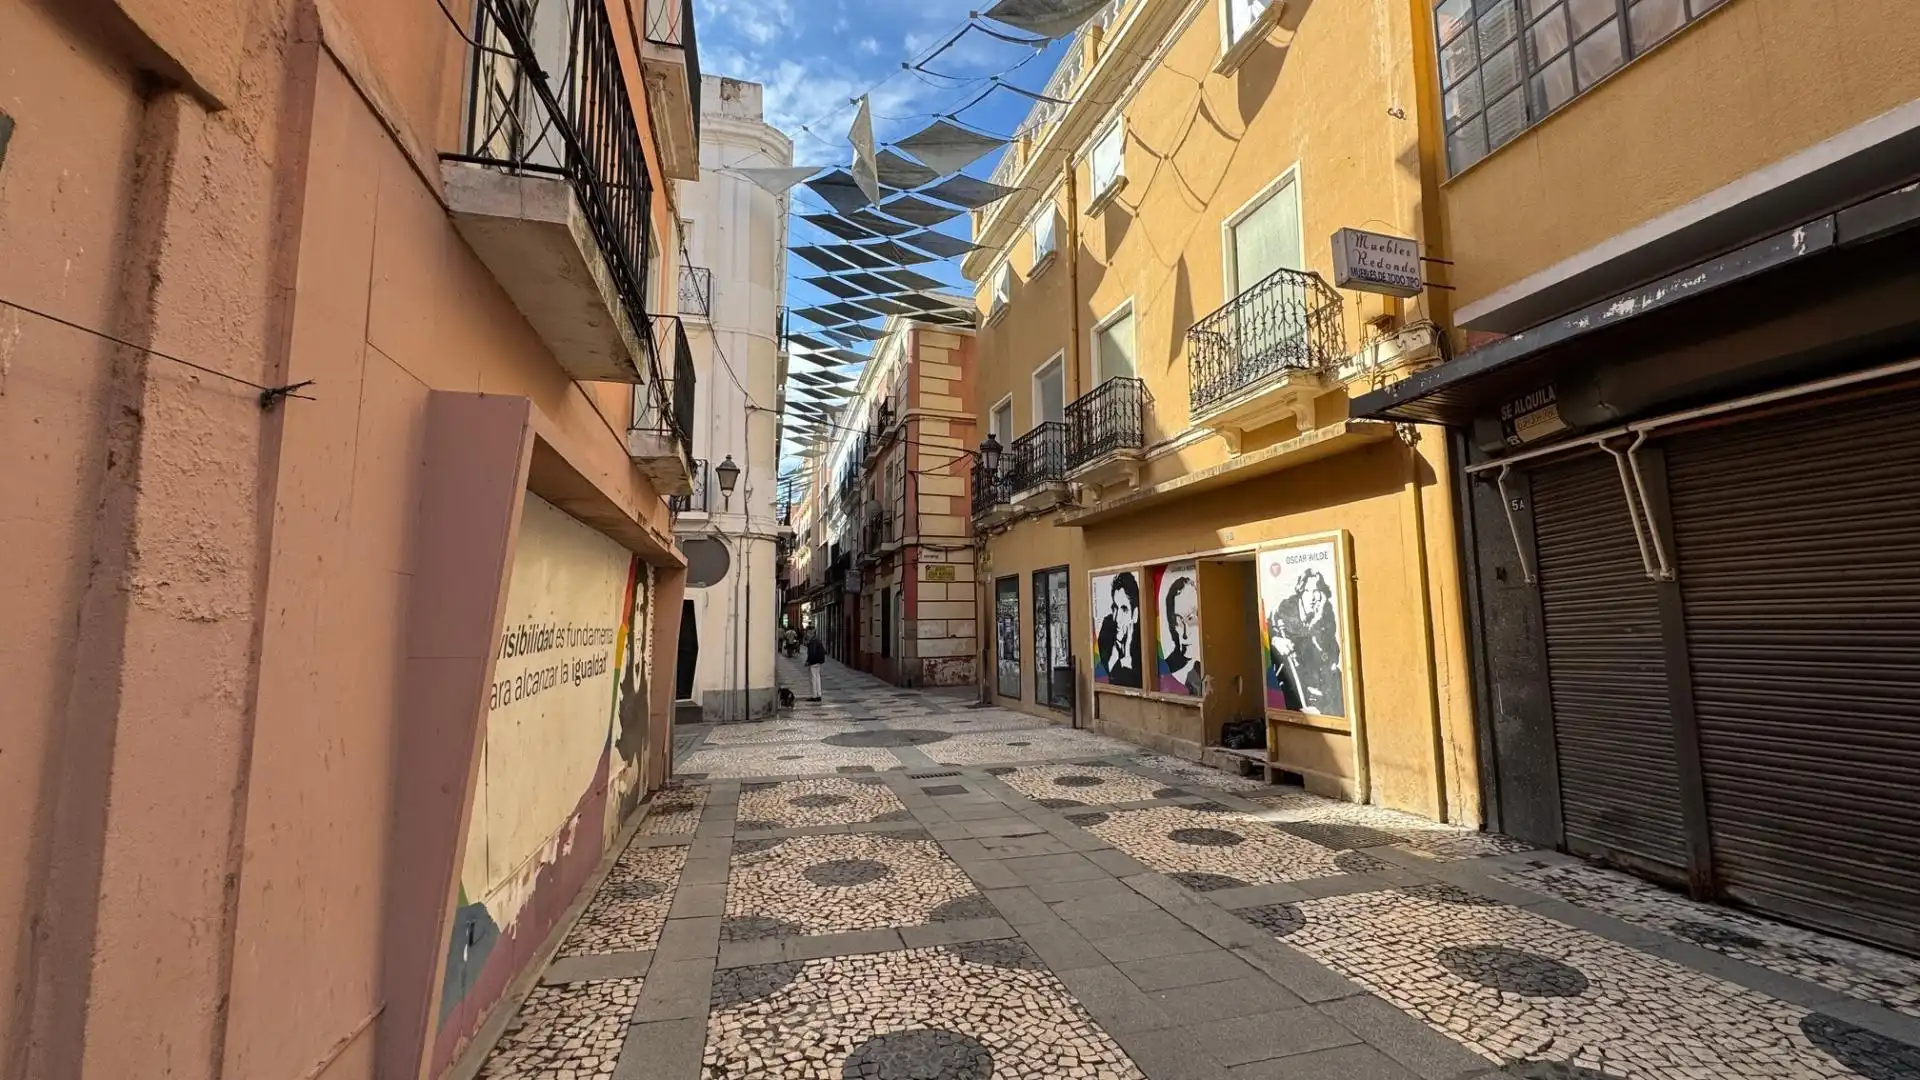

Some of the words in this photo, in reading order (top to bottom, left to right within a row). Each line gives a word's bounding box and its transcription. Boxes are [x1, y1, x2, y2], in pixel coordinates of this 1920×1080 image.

[1355, 233, 1411, 256] Muebles
[1353, 249, 1416, 274] Redondo
[1377, 271, 1386, 281] DE
[1387, 272, 1406, 285] TODO
[1501, 403, 1513, 421] SE
[1514, 385, 1556, 416] ALQUILA
[1511, 499, 1525, 511] 5A
[1285, 554, 1307, 565] OSCAR
[1308, 551, 1329, 562] WILDE
[555, 627, 566, 649] es
[490, 679, 512, 711] ara
[515, 667, 559, 702] alcanzar
[560, 658, 569, 685] la
